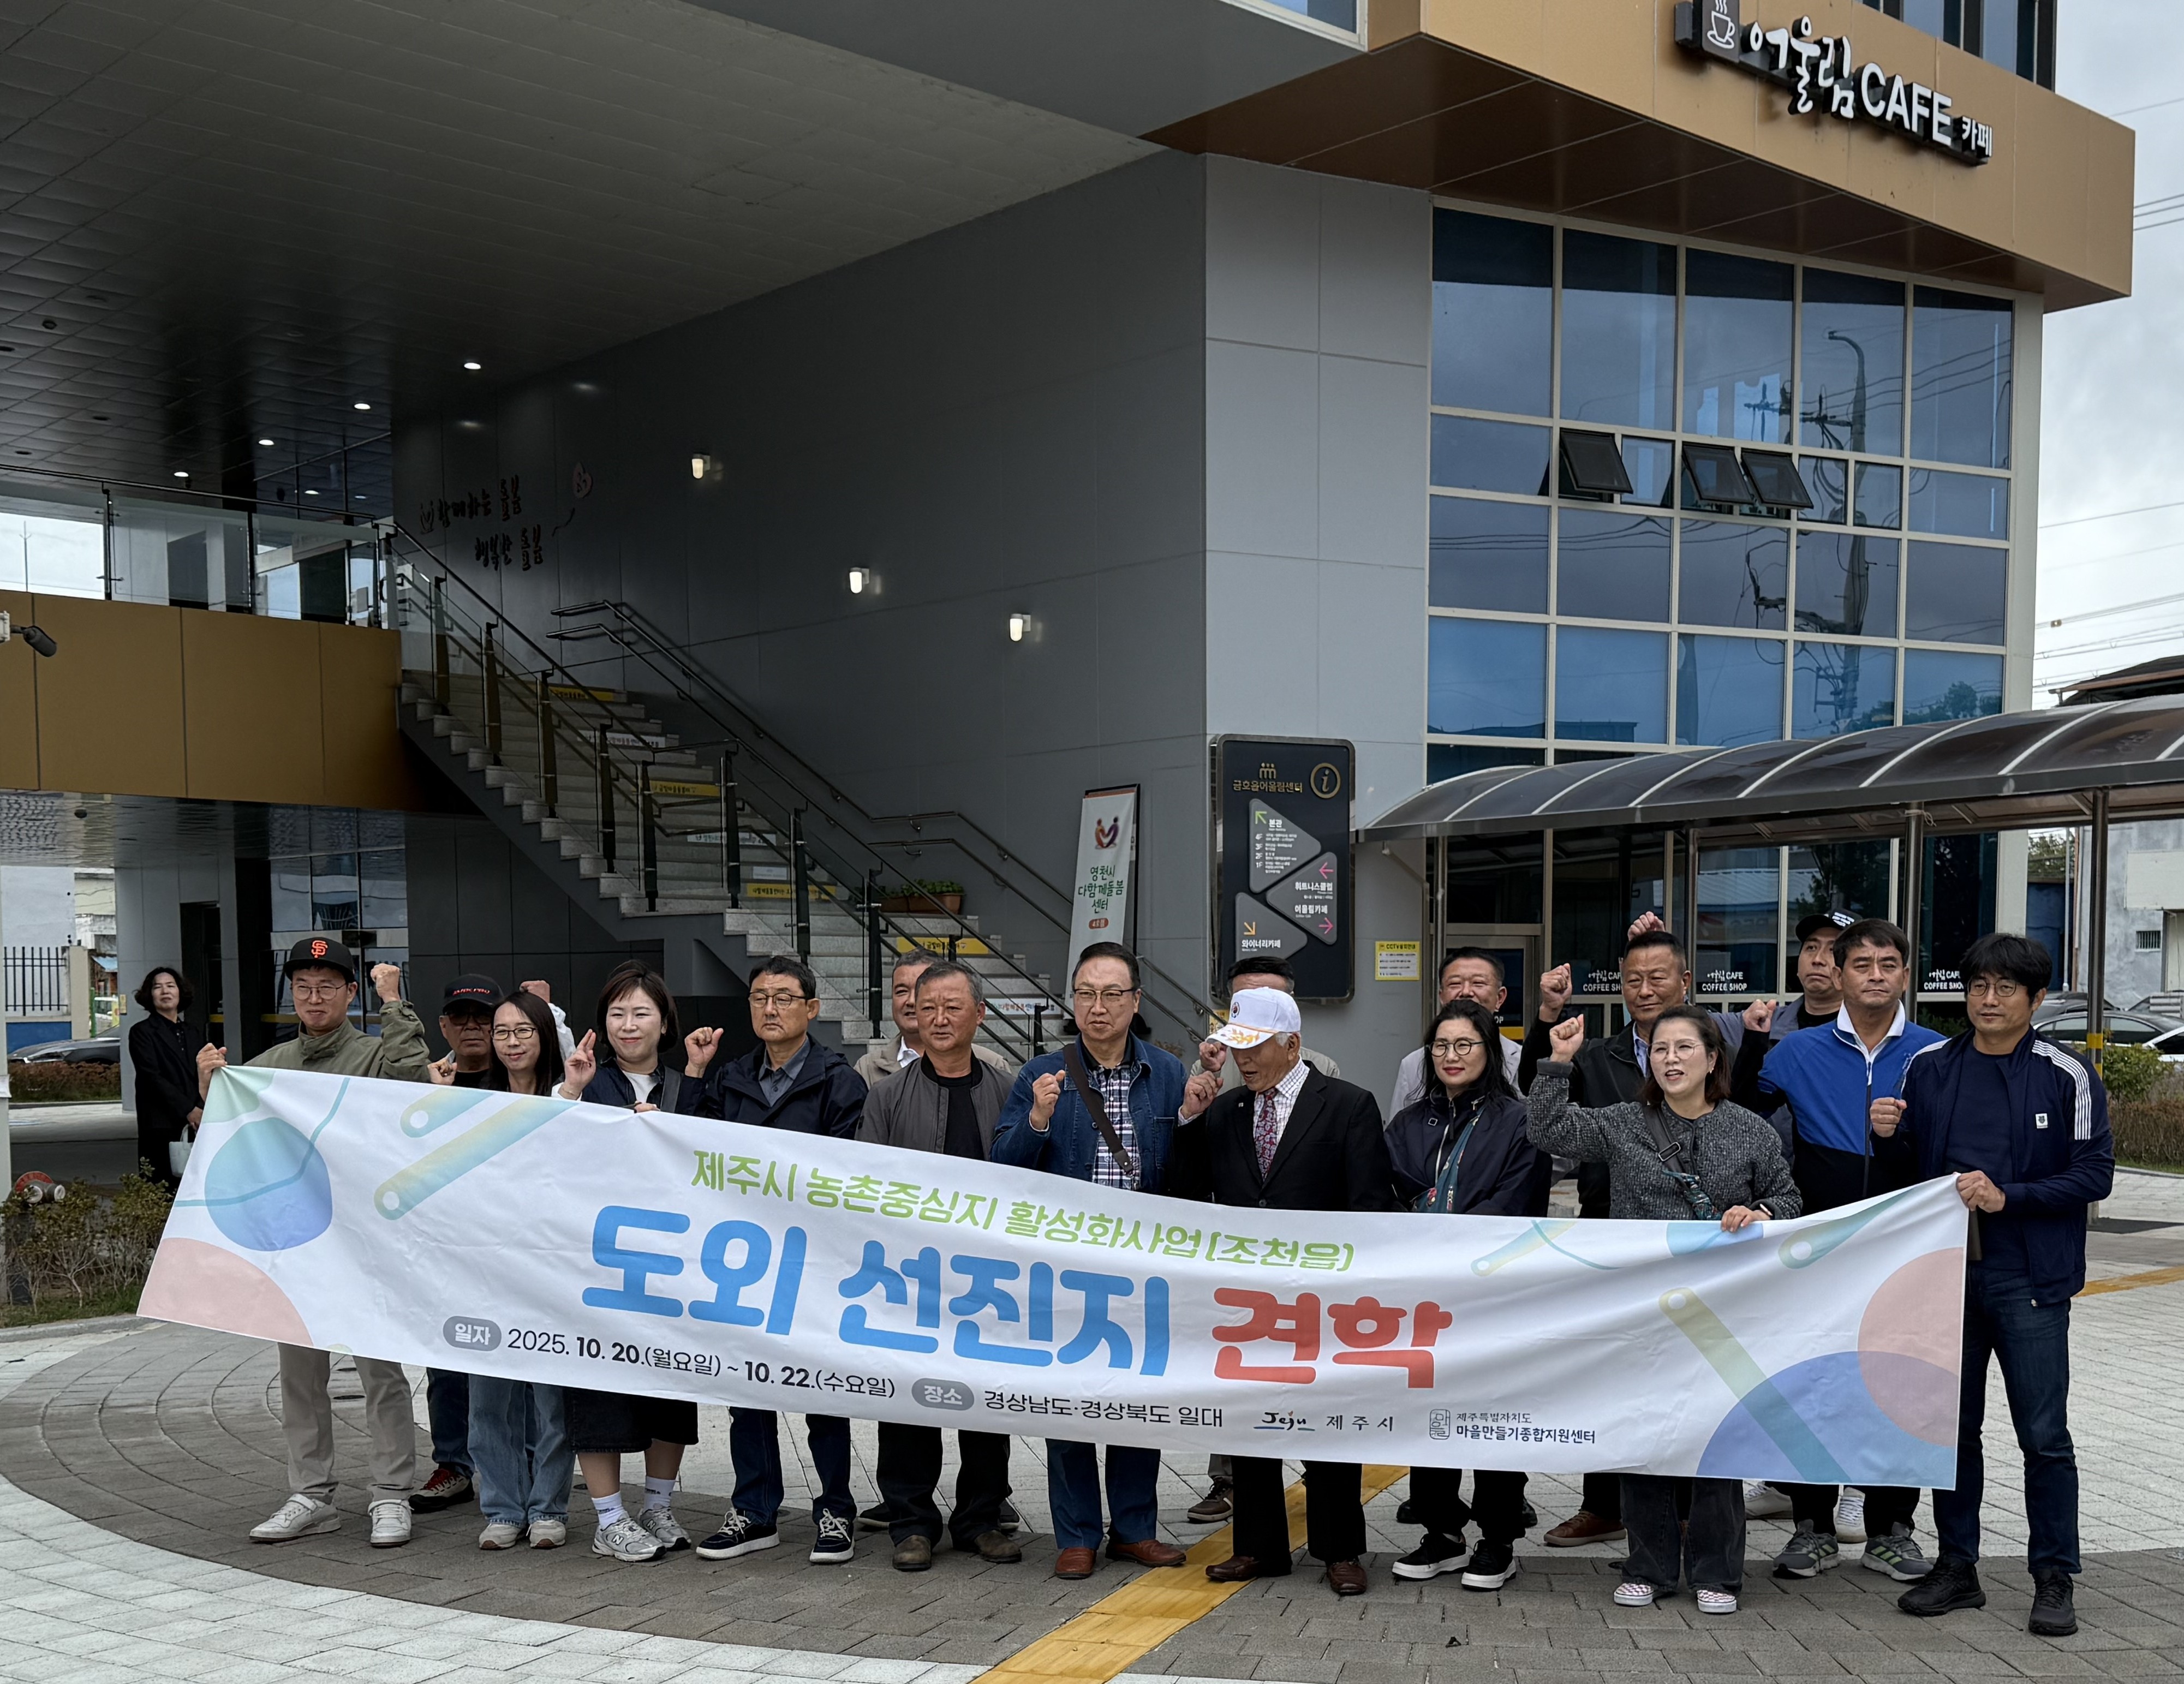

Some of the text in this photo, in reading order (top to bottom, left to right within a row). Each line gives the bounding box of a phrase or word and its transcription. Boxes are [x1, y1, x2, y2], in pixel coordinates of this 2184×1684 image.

[1749, 15, 1993, 157] 어울림 CAFE 카페
[500, 474, 522, 522] 돌봄
[520, 524, 544, 571] 돌봄
[1232, 779, 1303, 793] 금호읍어울림센터
[1090, 865, 1115, 881] 영천시
[1078, 880, 1124, 898] 다함께돌봄
[1091, 898, 1109, 913] 센터
[311, 940, 328, 958] SF
[1242, 939, 1281, 948] 와이너리카페
[1608, 971, 1621, 980] CAF
[1726, 971, 1744, 980] CAFE
[1946, 970, 1960, 979] CAF
[1583, 983, 1621, 992] COFFEE SH
[1702, 983, 1747, 992] COFFEE SHOP
[1924, 982, 1948, 990] COFFEE
[691, 1150, 798, 1202] 제주시
[805, 1167, 998, 1229] 농촌중심지
[582, 1205, 1453, 1389] 도외 선진지 견학
[454, 1323, 491, 1346] 일자
[507, 1328, 570, 1356] 2025.
[576, 1336, 605, 1360] 10.
[611, 1341, 721, 1377] 20.(월요일)
[744, 1360, 775, 1384] 10.
[781, 1366, 896, 1399] 22.(수요일)
[924, 1384, 963, 1405] 장소
[984, 1390, 1223, 1428] 경상남도·경상북도 일대
[1456, 1412, 1532, 1424] 제주특별자치도
[1456, 1424, 1596, 1444] 마을만들기종합지원센터
[612, 1534, 624, 1545] N
